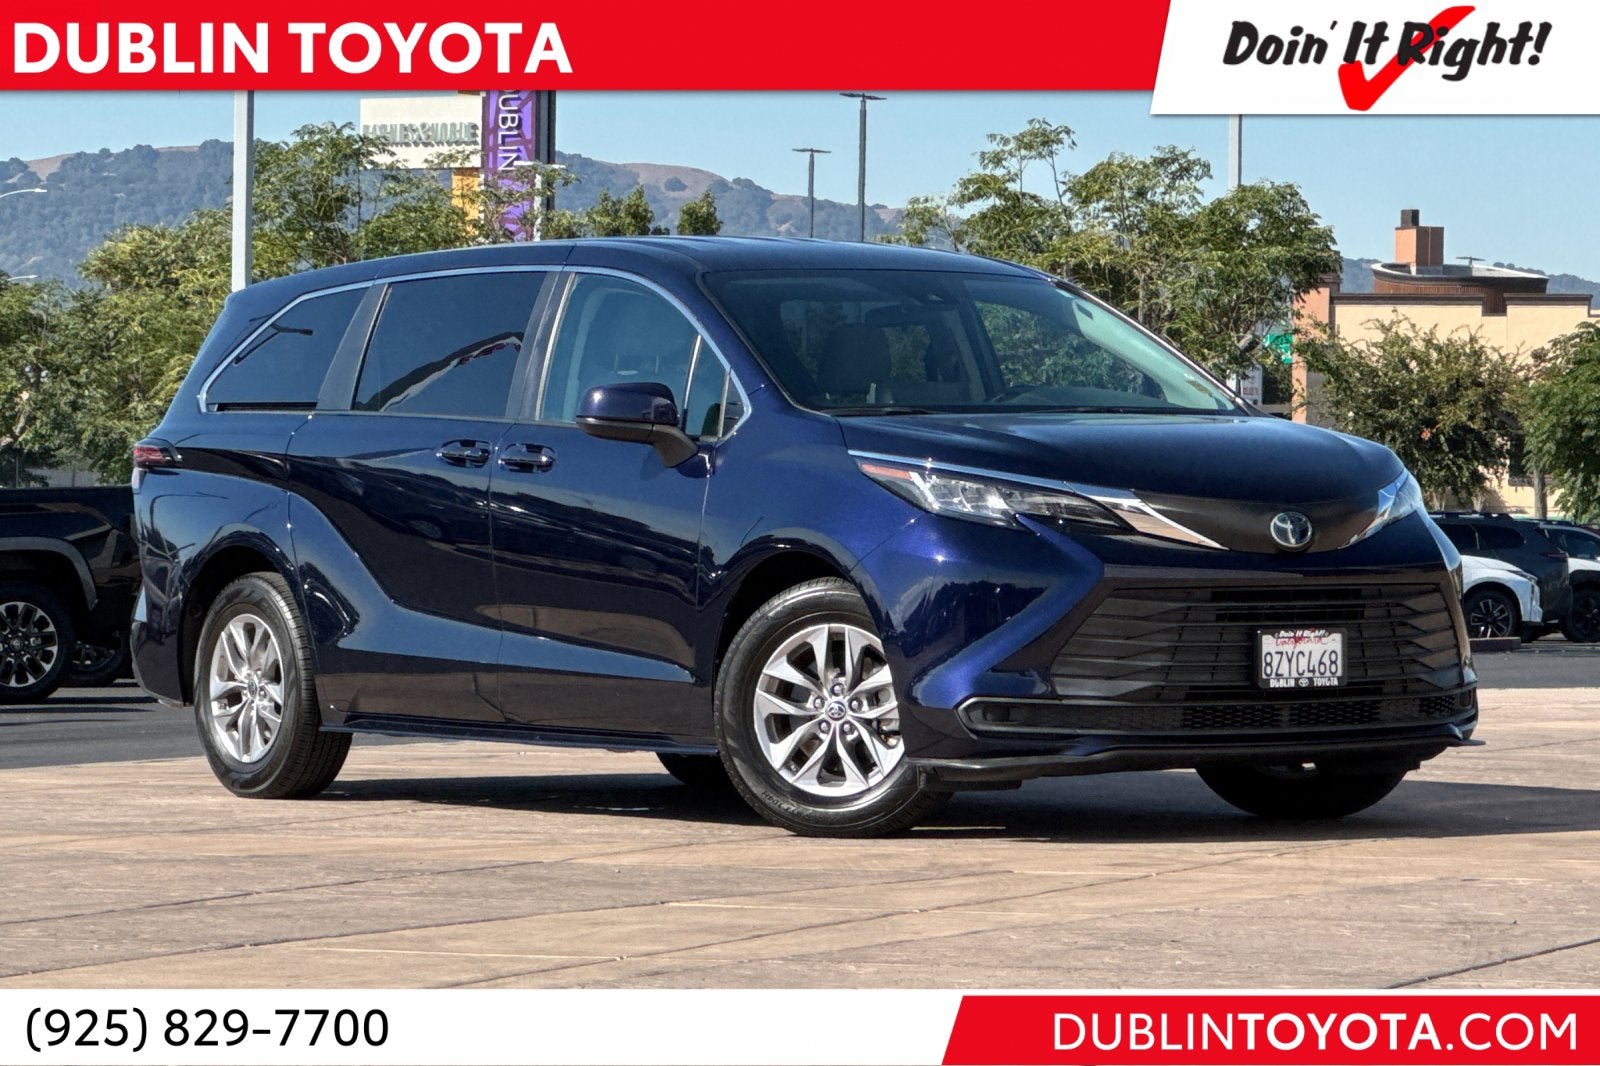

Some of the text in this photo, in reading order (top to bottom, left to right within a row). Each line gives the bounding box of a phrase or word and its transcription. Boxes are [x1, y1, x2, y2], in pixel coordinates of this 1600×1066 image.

[498, 90, 520, 171] UBLIN
[1263, 650, 1339, 678] 8ZYC468
[1269, 677, 1339, 688] DUBLIN TOYOTA
